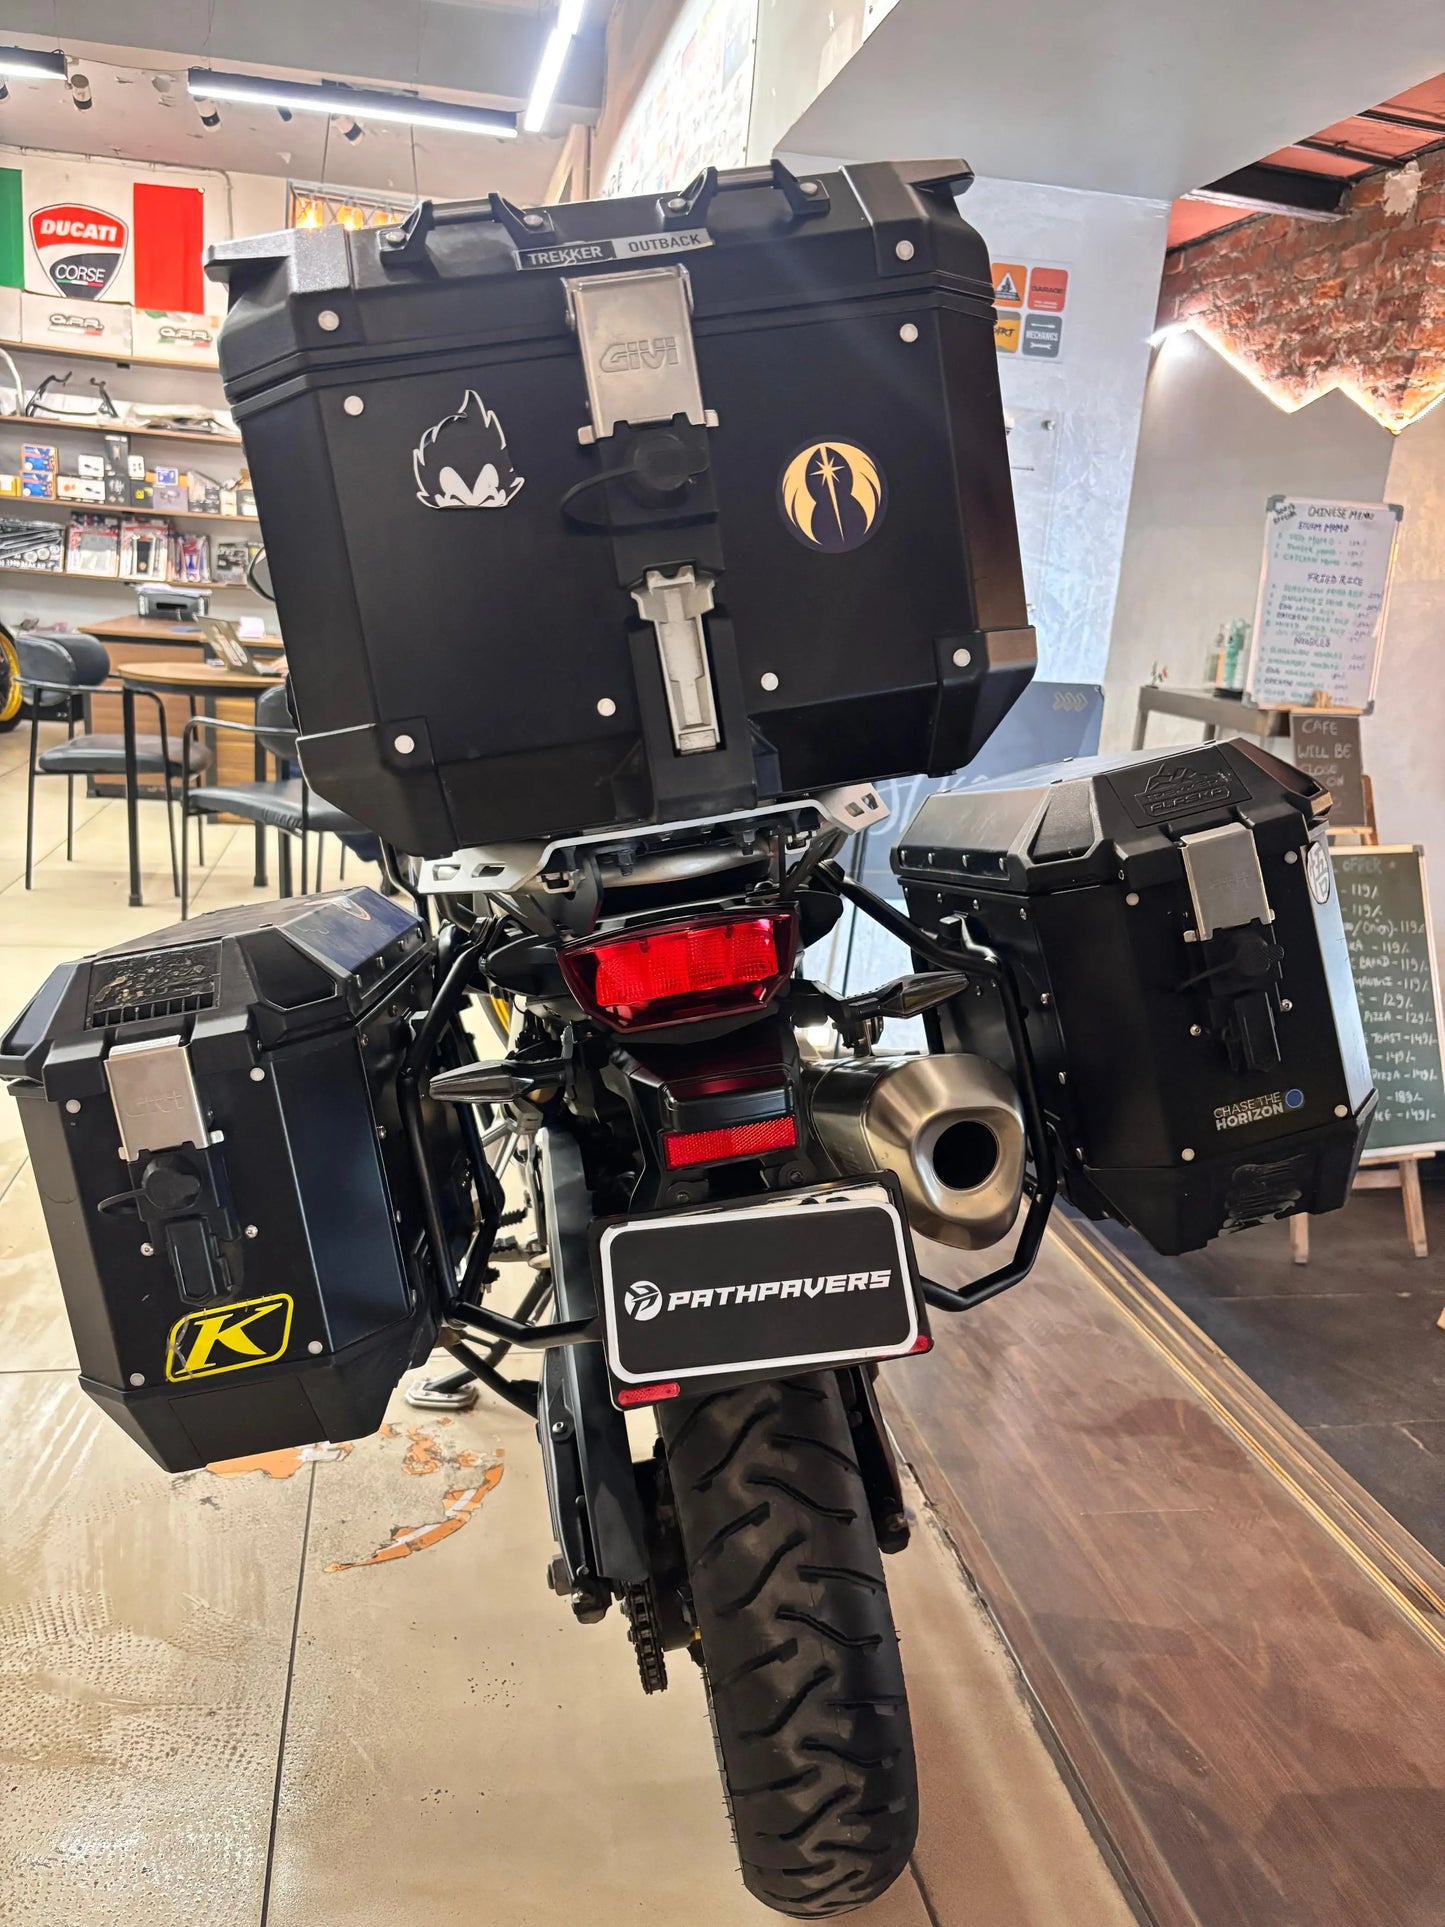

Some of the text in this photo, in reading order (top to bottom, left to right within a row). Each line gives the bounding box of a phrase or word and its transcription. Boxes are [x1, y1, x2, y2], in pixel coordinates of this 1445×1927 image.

[40, 219, 118, 242] DUCATI
[527, 234, 701, 266] TREKKER OUTBACK
[55, 264, 106, 283] CORSE
[600, 336, 678, 373] GIVI
[1301, 718, 1338, 736] CAFE
[1297, 743, 1353, 759] WILL BE
[1326, 775, 1344, 788] ON
[1342, 857, 1383, 874] OFFER
[1370, 1032, 1401, 1044] TOAST
[1213, 1091, 1282, 1119] CHASE THE
[1215, 1102, 1284, 1131] HORIZON
[666, 1269, 892, 1312] PATHPAVERS
[174, 1302, 283, 1375] K
